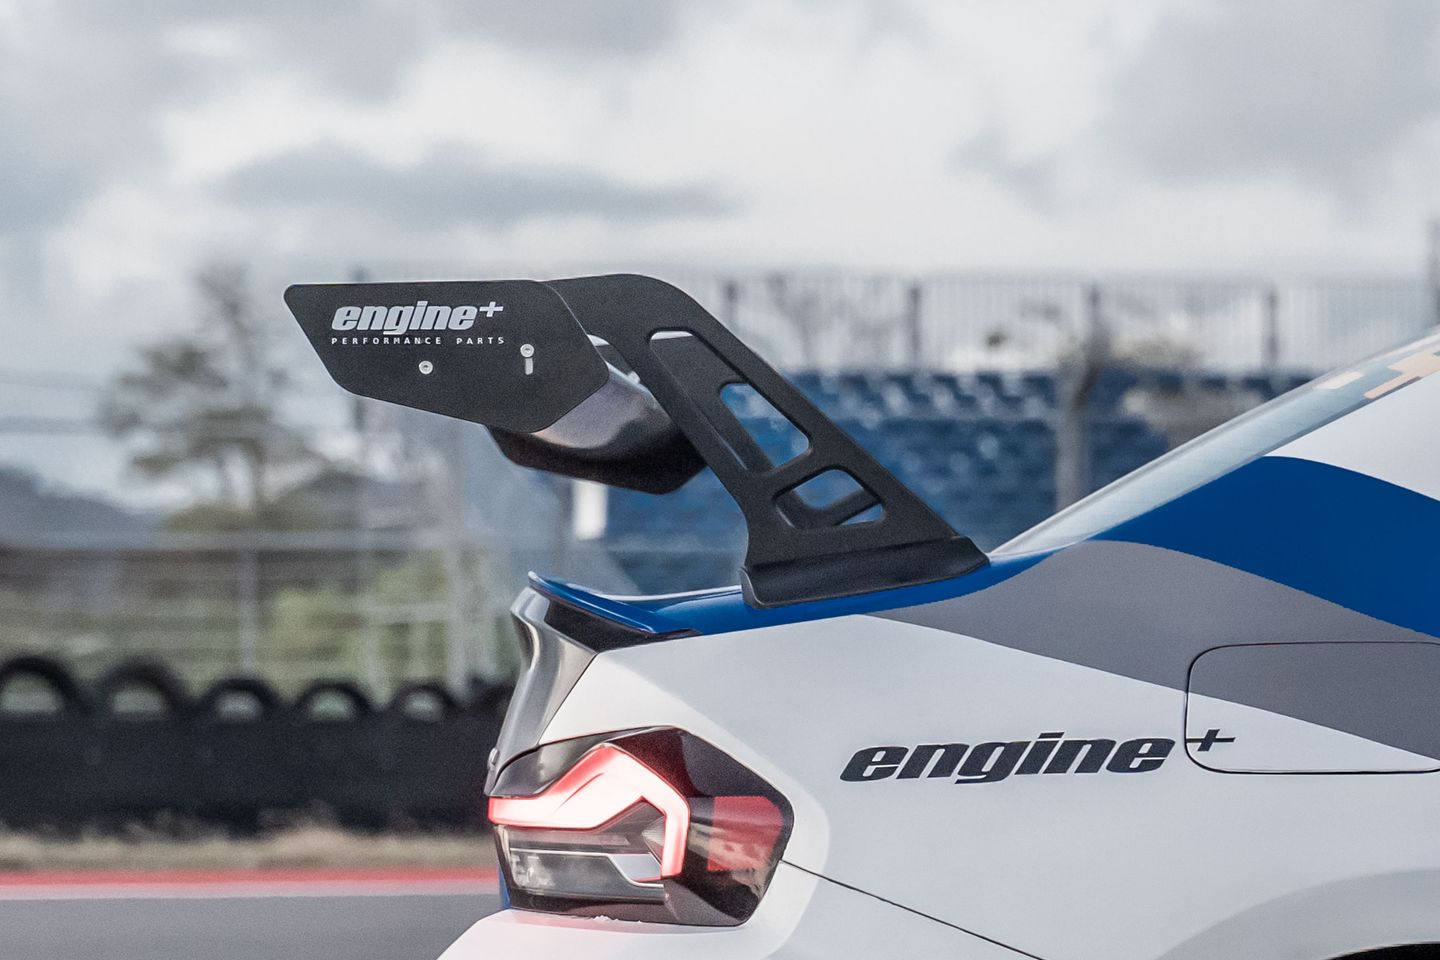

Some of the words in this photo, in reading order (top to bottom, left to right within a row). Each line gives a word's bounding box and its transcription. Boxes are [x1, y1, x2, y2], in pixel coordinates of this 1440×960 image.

[331, 300, 504, 336] engine+
[331, 337, 442, 345] PERFORMANCE
[456, 336, 505, 345] PARTS
